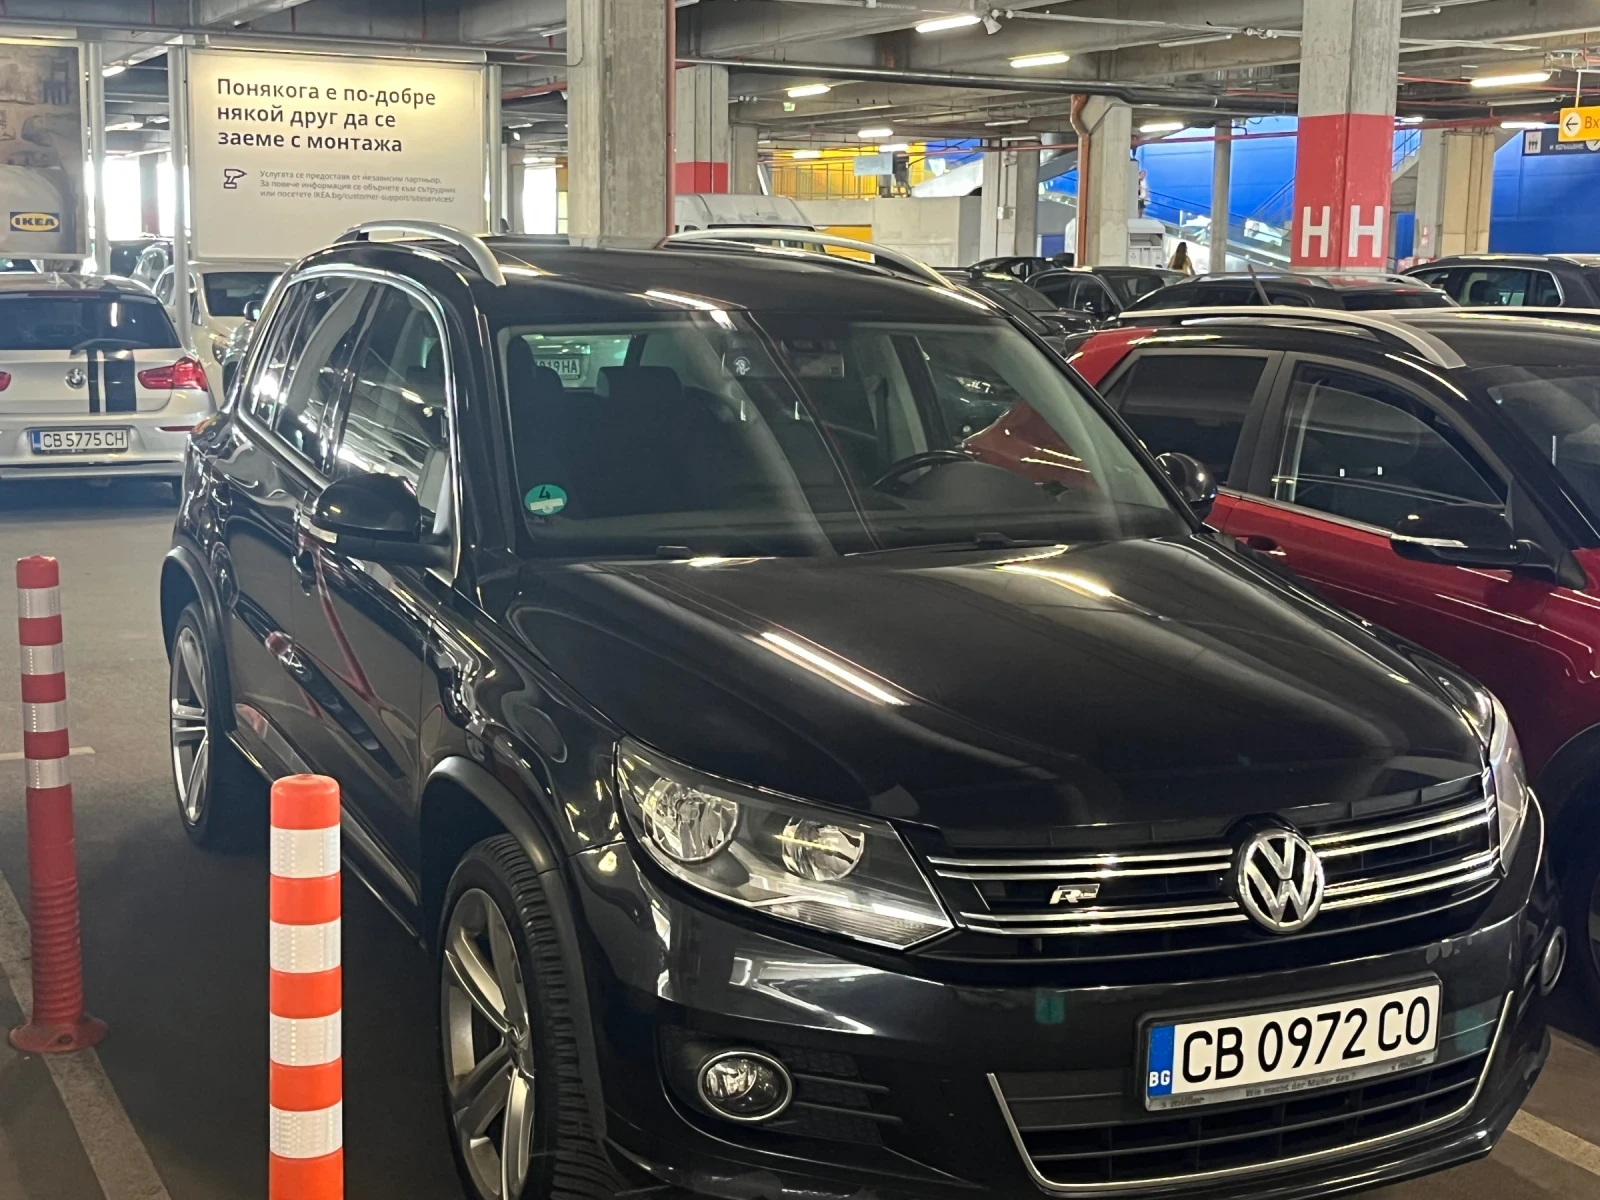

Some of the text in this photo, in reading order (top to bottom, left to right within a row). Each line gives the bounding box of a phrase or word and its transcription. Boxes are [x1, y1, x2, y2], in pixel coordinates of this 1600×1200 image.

[217, 78, 436, 109] Понякога е по-добре
[217, 105, 396, 128] някой друг да се
[218, 131, 402, 152] заеме с монтажа
[260, 170, 294, 179] Услугата
[306, 172, 350, 180] предоставя
[302, 181, 351, 190] информация
[15, 217, 56, 226] IKEA
[1301, 206, 1330, 257] H
[1348, 205, 1384, 257] H
[562, 360, 578, 373] HA
[43, 431, 124, 448] CB 5775 CH
[539, 486, 551, 499] 4
[1182, 995, 1431, 1084] CB 0972 CO
[1149, 1070, 1171, 1087] BG
